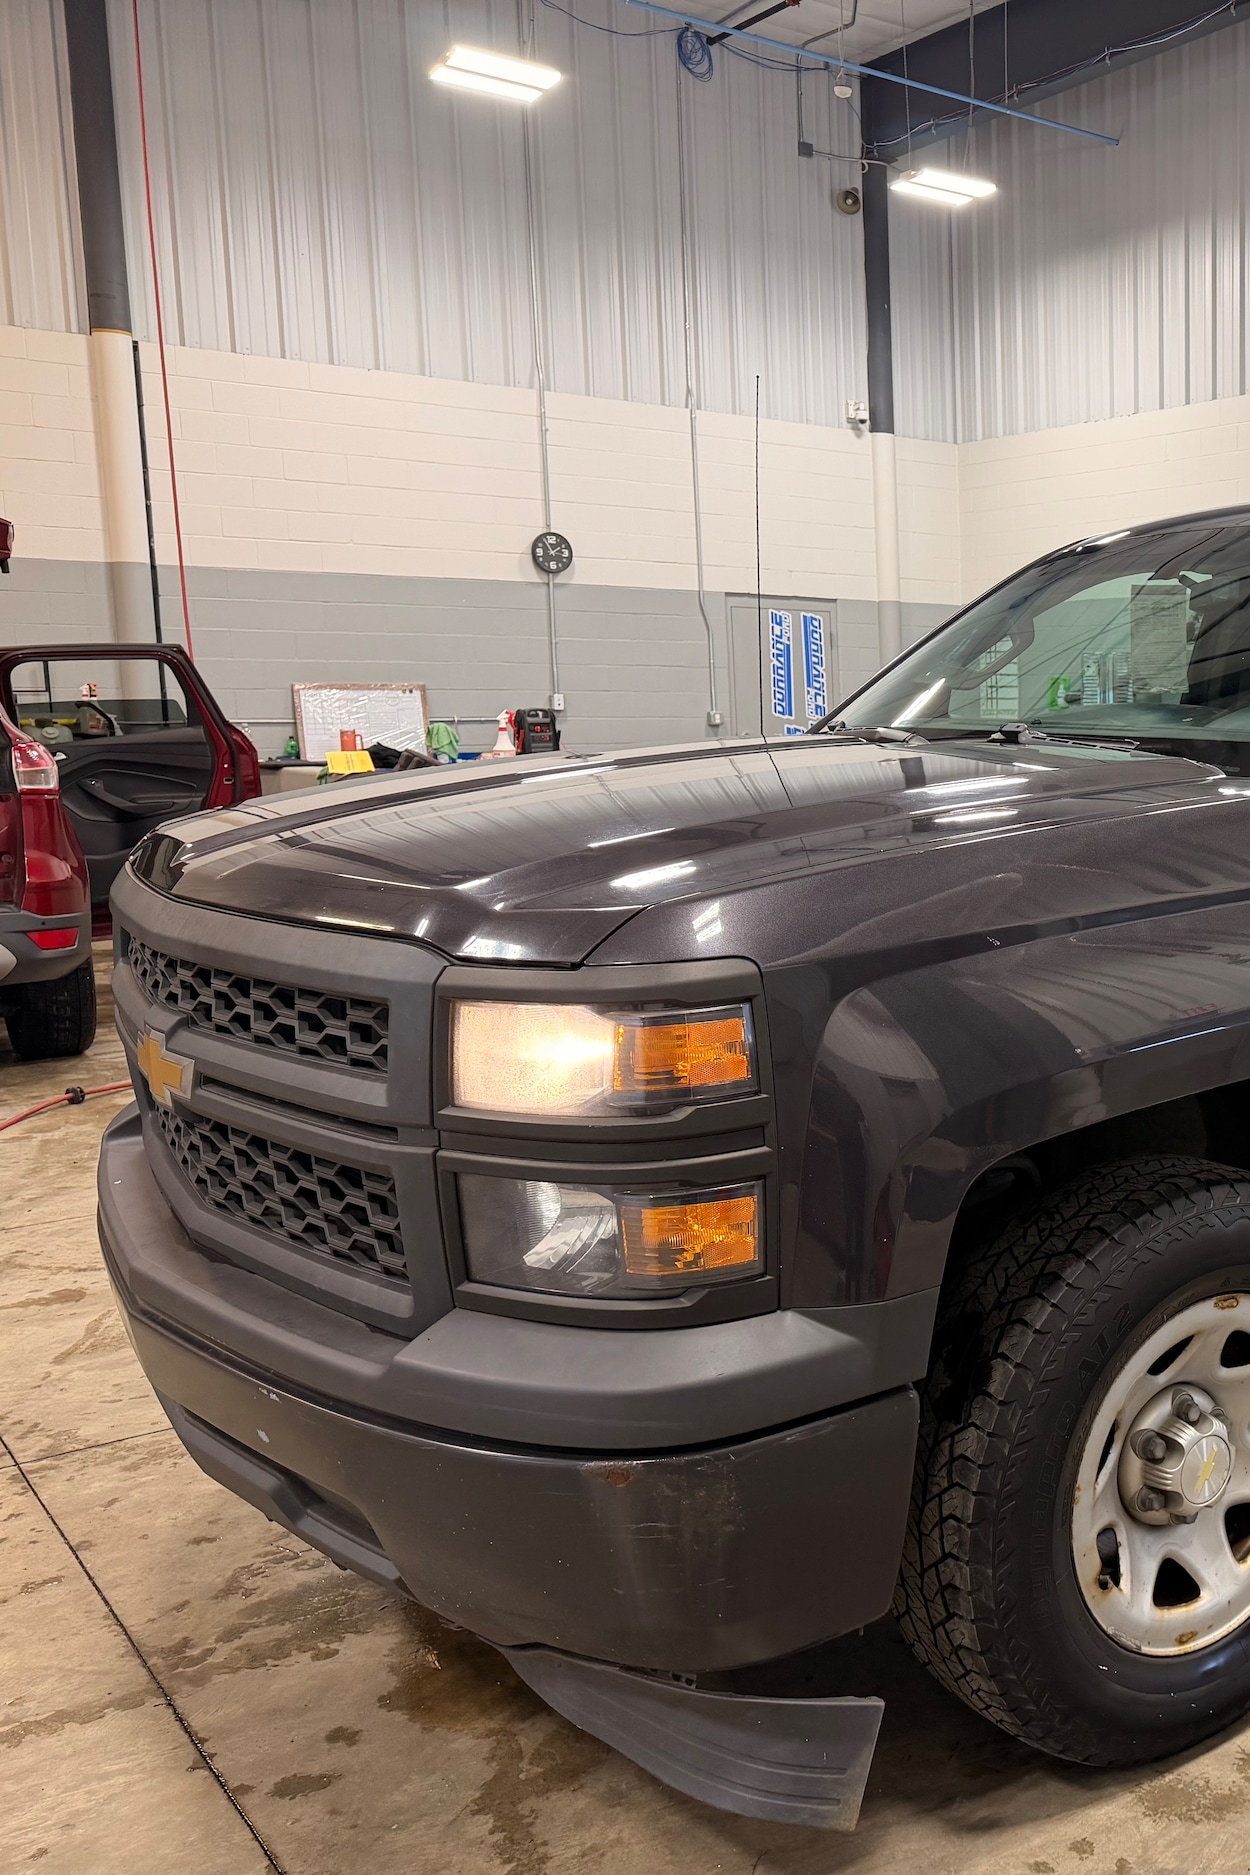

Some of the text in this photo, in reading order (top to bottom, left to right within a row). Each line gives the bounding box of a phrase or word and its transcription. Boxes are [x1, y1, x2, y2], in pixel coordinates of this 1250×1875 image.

[546, 535, 557, 544] 12
[536, 547, 544, 556] 9
[561, 549, 569, 557] 3
[549, 561, 557, 570] 6
[771, 611, 787, 716] DORRANCE
[809, 615, 826, 717] DORRANCE
